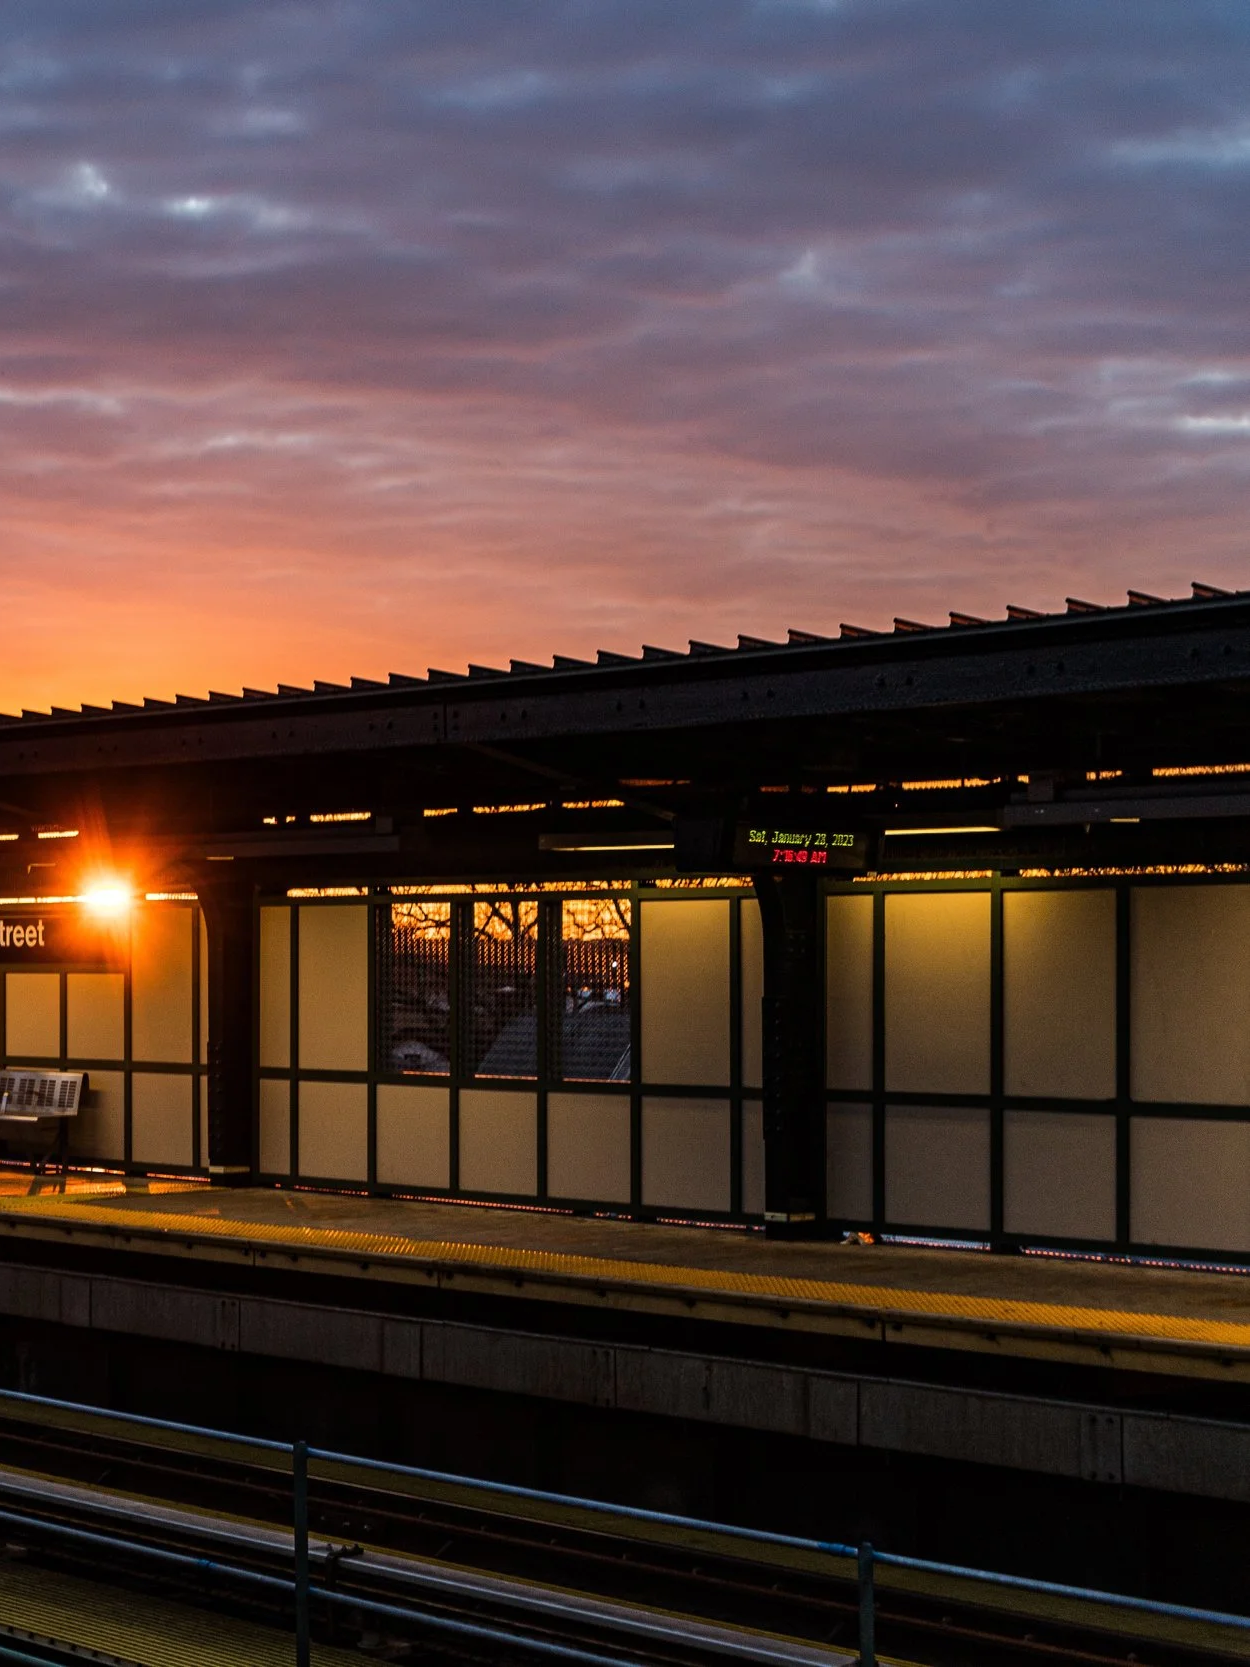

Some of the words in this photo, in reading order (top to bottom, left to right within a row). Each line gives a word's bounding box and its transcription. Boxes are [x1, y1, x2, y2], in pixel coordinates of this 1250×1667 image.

[771, 831, 812, 848] January
[831, 833, 855, 847] 2023
[810, 851, 828, 864] AM
